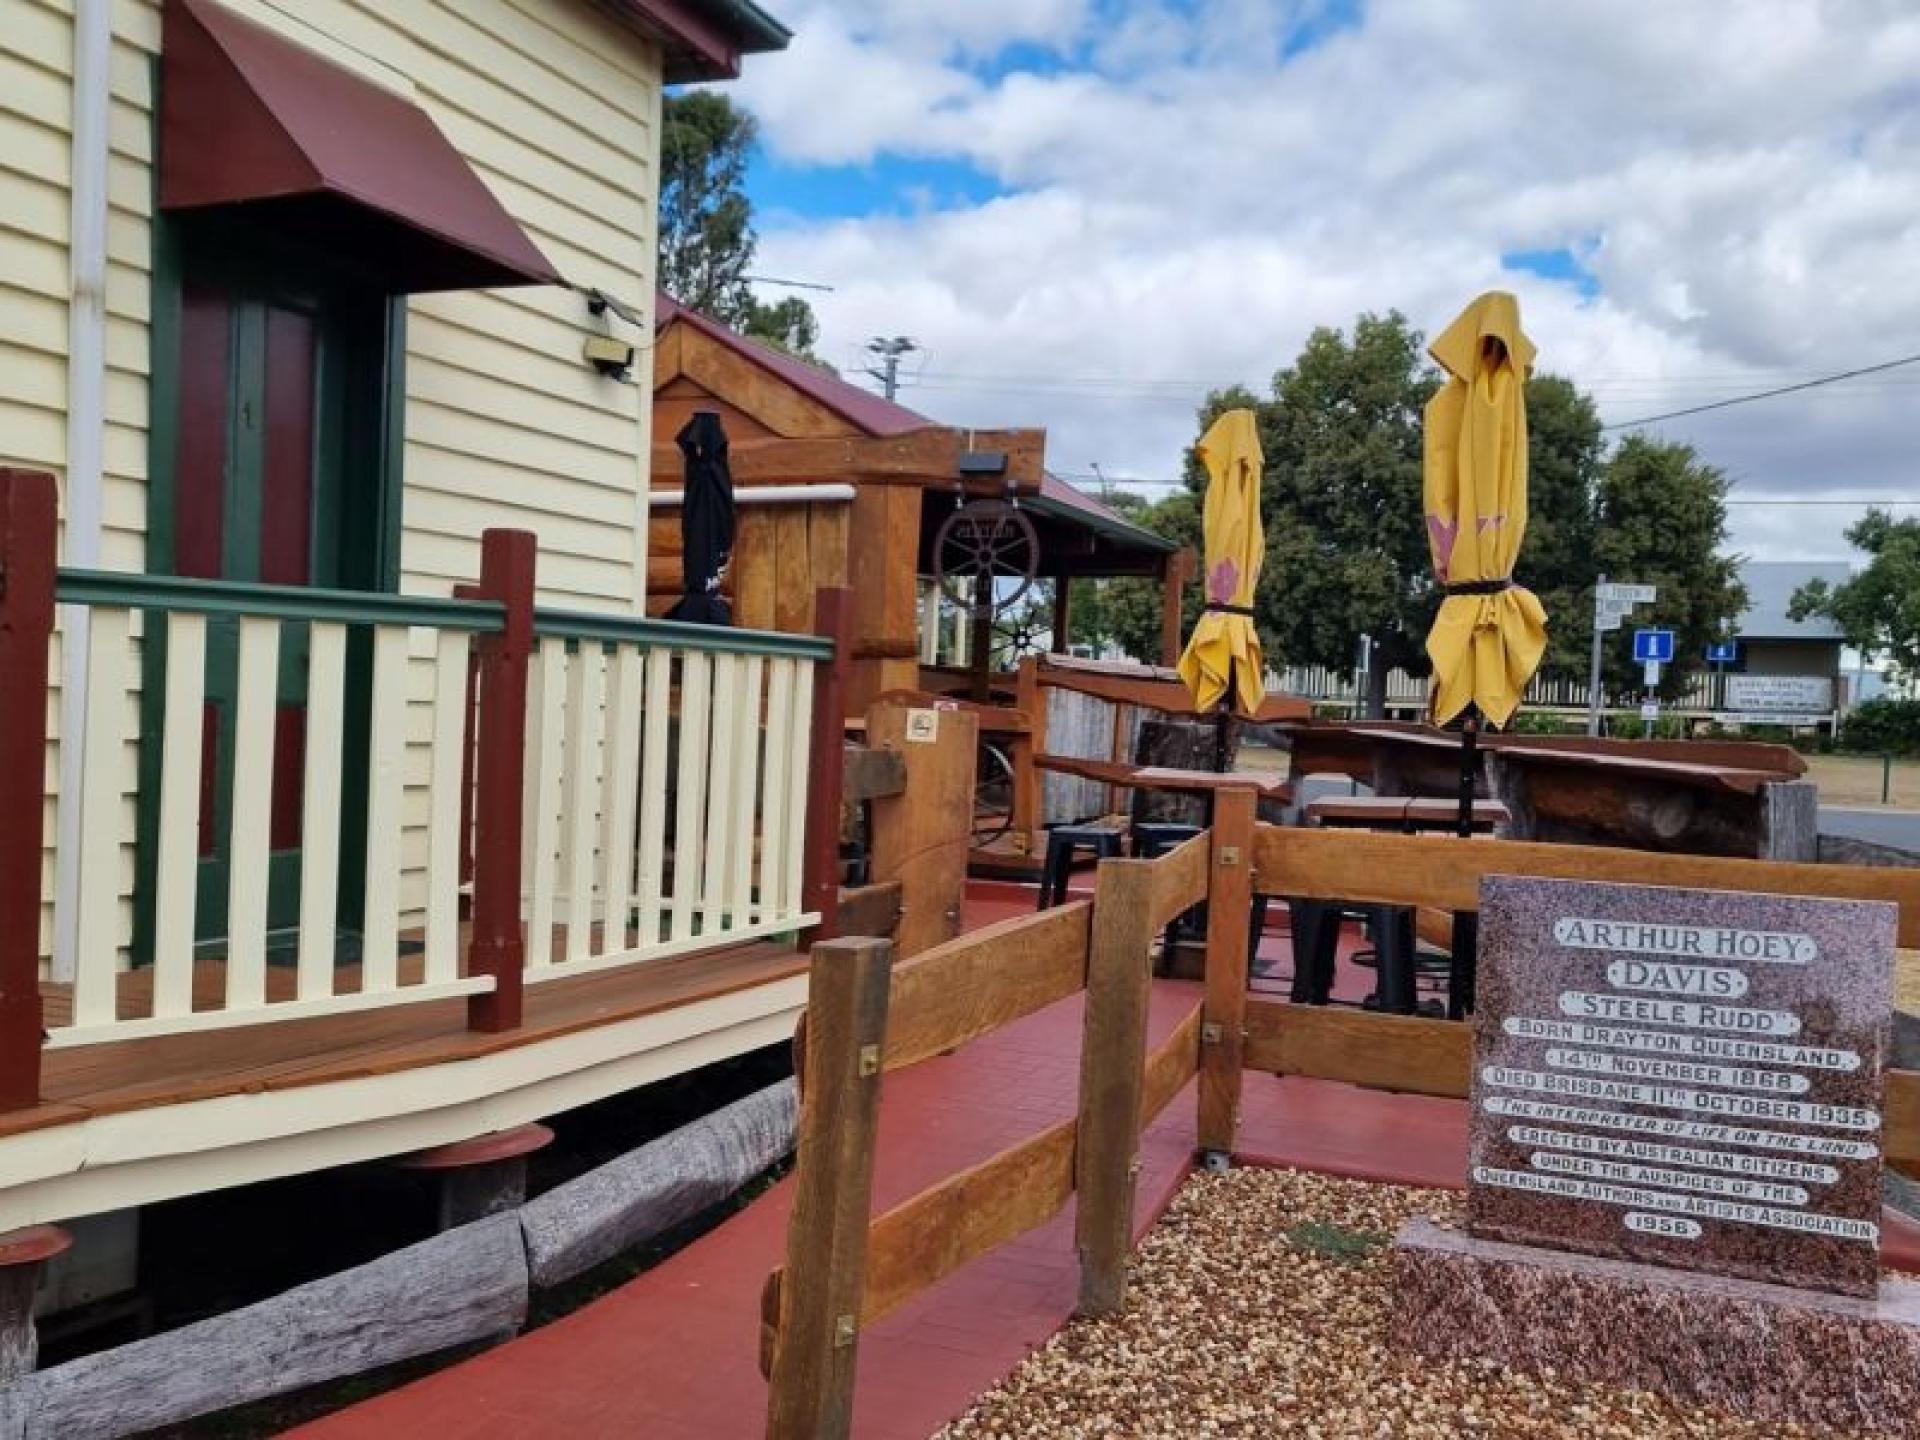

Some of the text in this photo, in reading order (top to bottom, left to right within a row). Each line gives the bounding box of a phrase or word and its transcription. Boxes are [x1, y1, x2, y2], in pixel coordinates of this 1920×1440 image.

[1566, 921, 1802, 960] ARTHUR HOEY
[1624, 961, 1732, 994] DAVIS
[1519, 1018, 1573, 1038] BORN
[1583, 1026, 1681, 1050] DRAYTON
[1612, 1056, 1722, 1083] NOVEMBER
[1732, 1069, 1791, 1088] 1868
[1494, 1068, 1537, 1087] DIED
[1544, 1075, 1641, 1100] BRISBANE
[1696, 1093, 1801, 1118] OCTOBER
[1811, 1105, 1868, 1126] 1935
[1537, 1105, 1656, 1130] INTERPRETER
[1663, 1120, 1686, 1133] OF
[1691, 1126, 1730, 1138] LIFE
[1734, 1131, 1760, 1142] ON
[1766, 1134, 1802, 1147] THE
[1519, 1128, 1825, 1180] ERECTED BY AUSTRALIAN CITIZENS
[1540, 1155, 1799, 1200] UNDER THE AUSPICES OF THE
[1480, 1167, 1577, 1194] QUEENSLAND
[1581, 1184, 1654, 1206] AUTHORS
[1684, 1198, 1755, 1220] ARTISTS
[1758, 1208, 1871, 1237] ASSOCIATION
[1636, 1216, 1688, 1234] 1956
